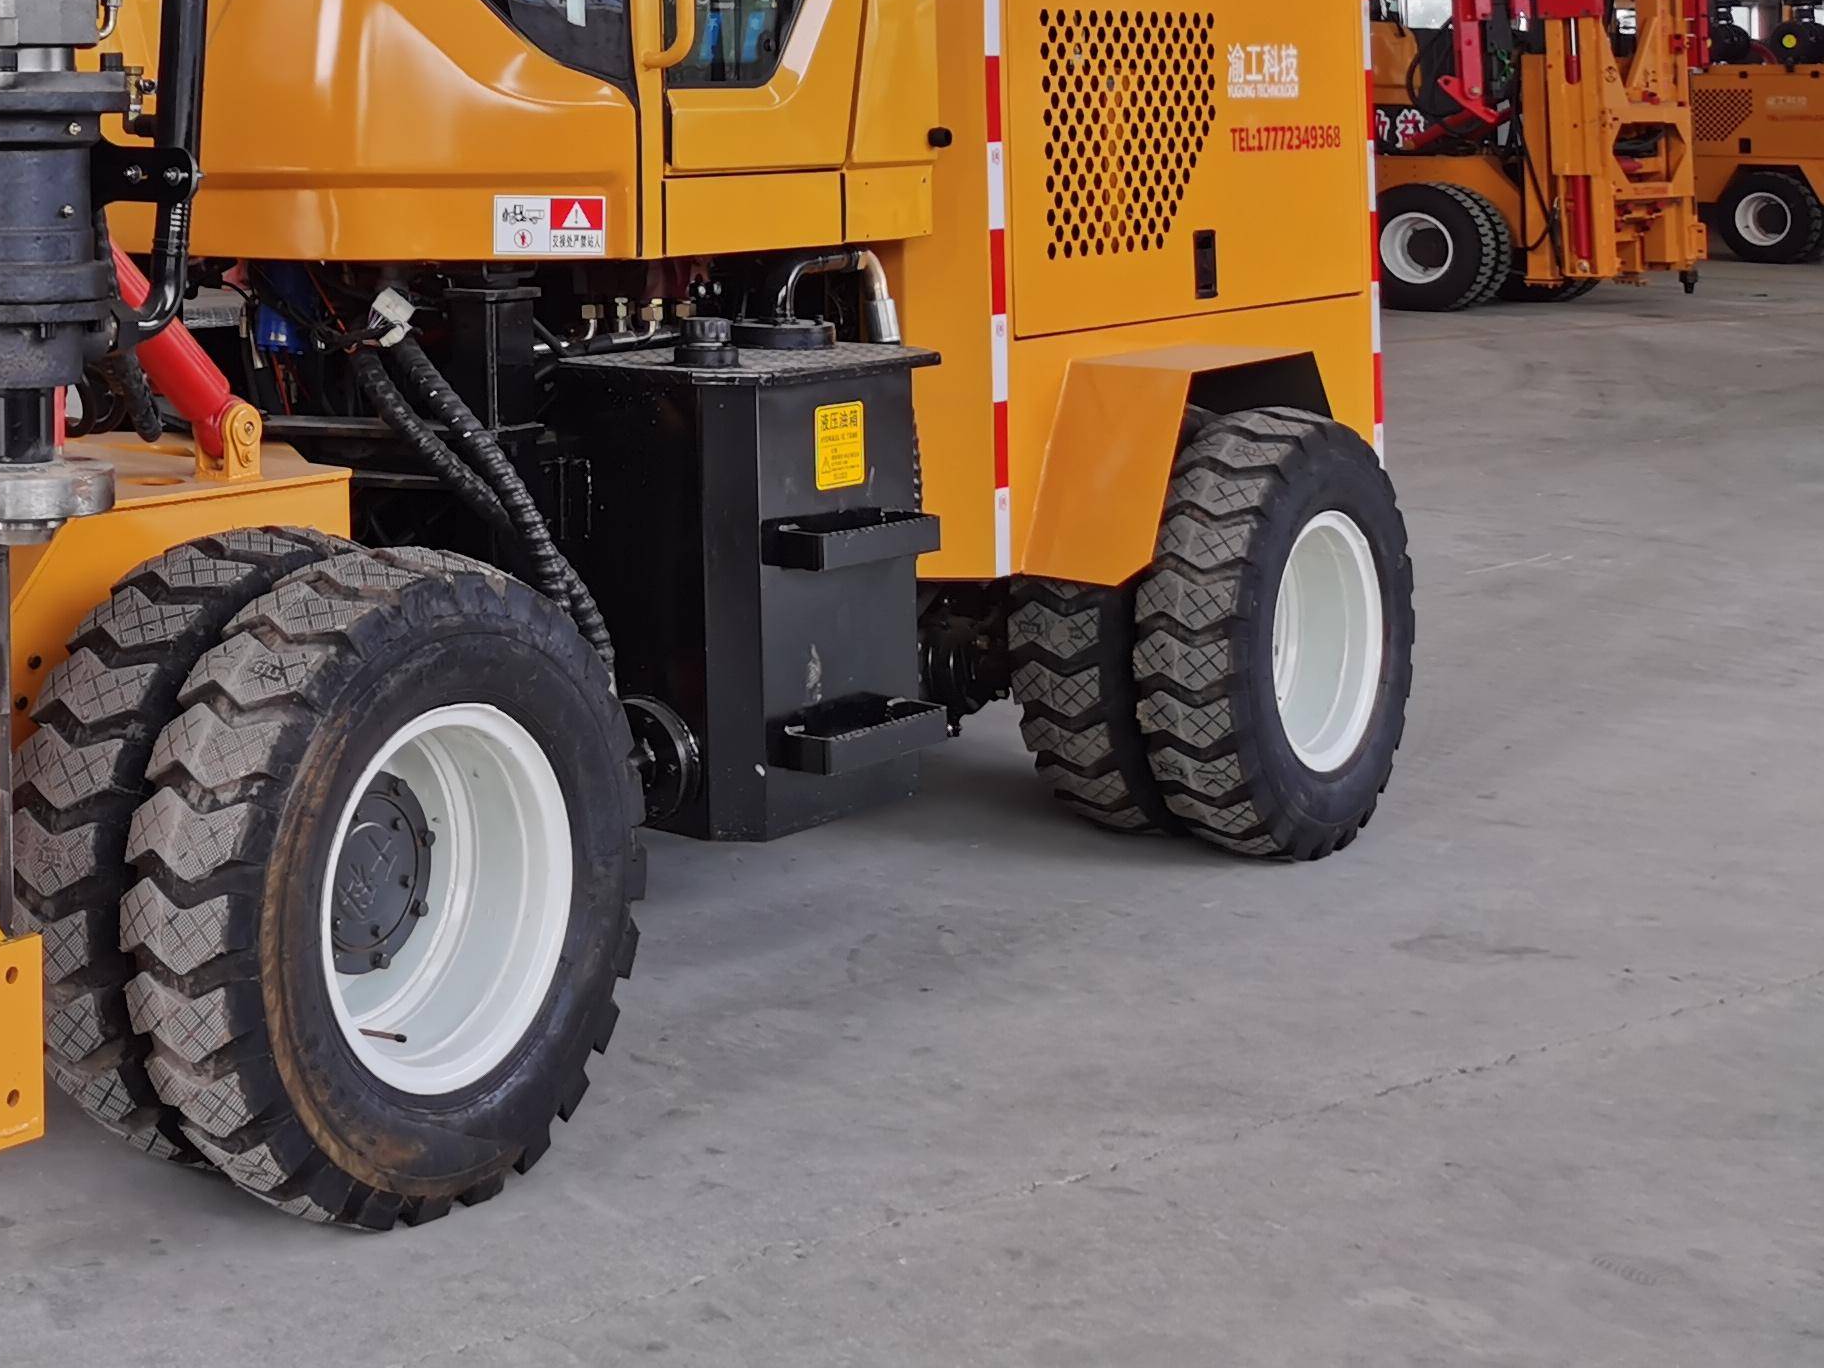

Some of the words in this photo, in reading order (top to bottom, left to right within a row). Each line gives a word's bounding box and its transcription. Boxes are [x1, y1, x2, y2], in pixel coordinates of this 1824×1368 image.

[1227, 43, 1299, 83] 渝工科技
[1230, 125, 1341, 153] TEL:17772349368
